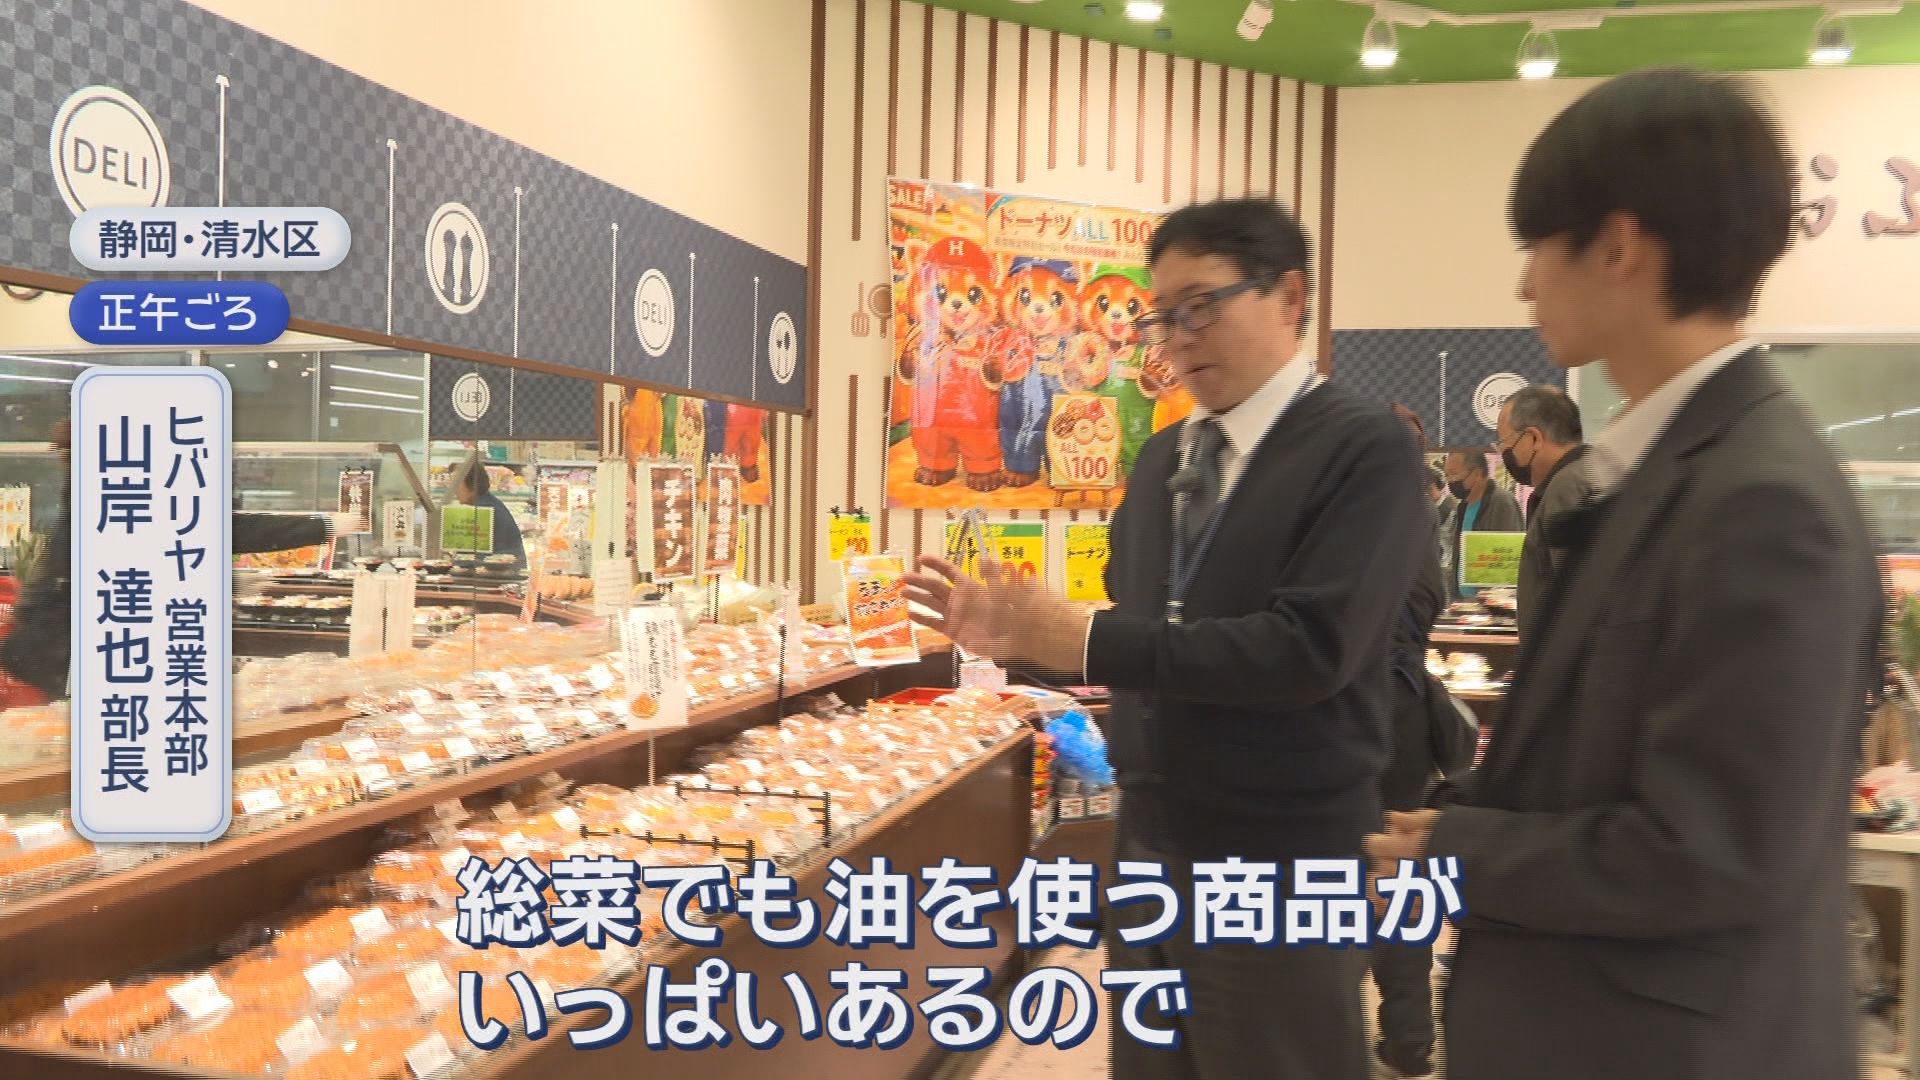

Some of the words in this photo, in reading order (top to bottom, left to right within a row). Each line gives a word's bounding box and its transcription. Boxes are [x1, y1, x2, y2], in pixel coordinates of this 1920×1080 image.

[73, 136, 148, 190] DELI
[948, 240, 965, 256] H
[641, 300, 668, 326] DELI
[663, 479, 684, 568] チキン
